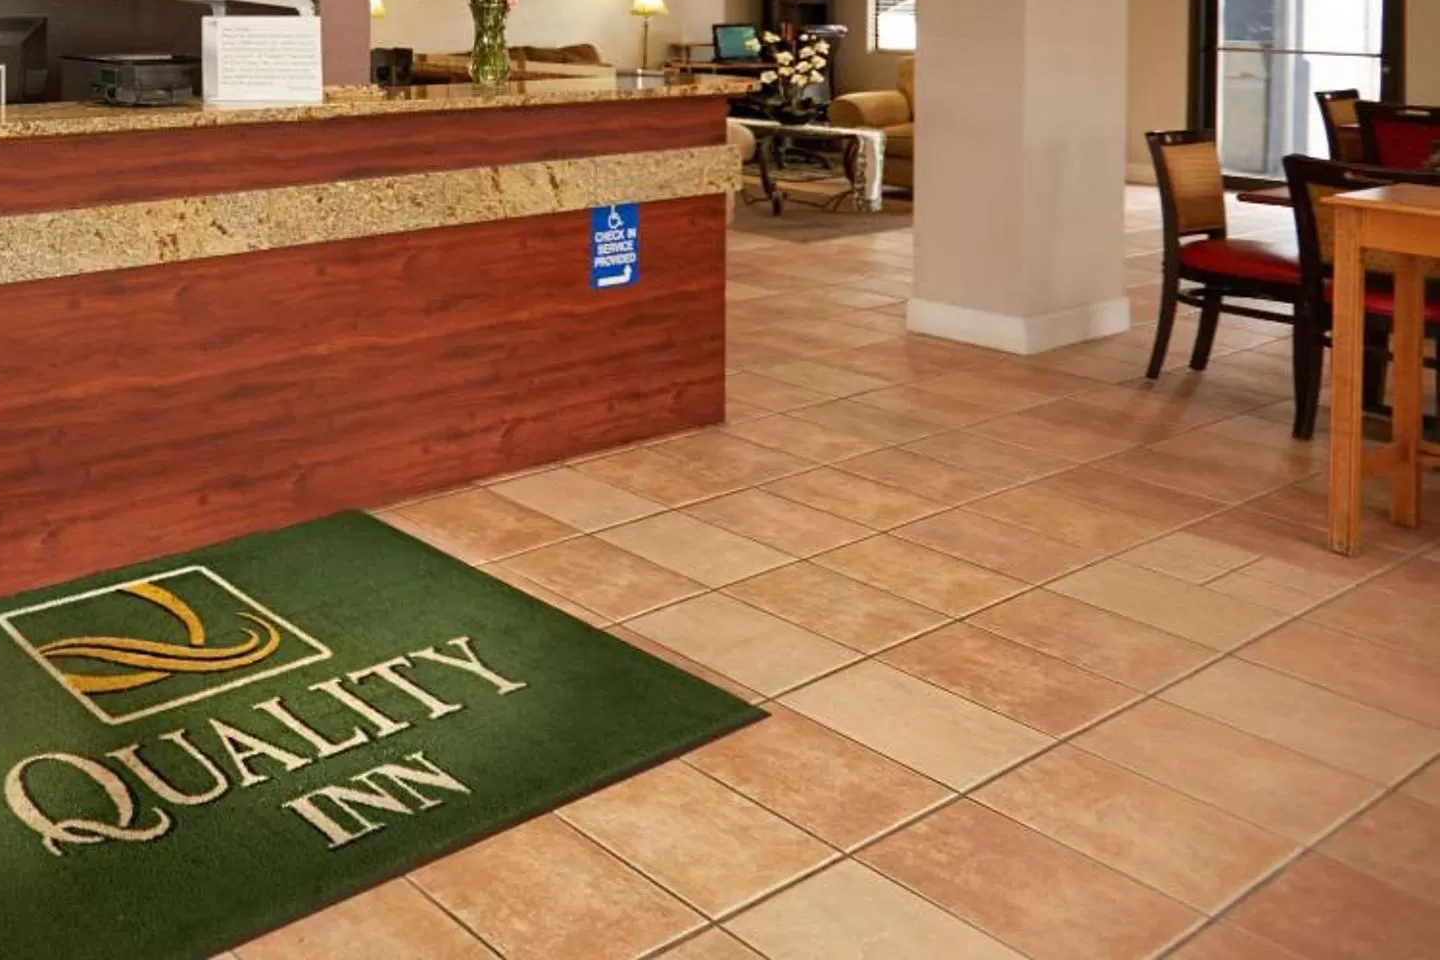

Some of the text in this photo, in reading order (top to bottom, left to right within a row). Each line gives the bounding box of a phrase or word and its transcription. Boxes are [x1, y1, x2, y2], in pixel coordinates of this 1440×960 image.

[595, 228, 636, 243] CHECK IN
[597, 240, 634, 255] SERVICE
[594, 252, 637, 268] PROVIDED
[4, 637, 526, 856] QUALITY
[281, 751, 473, 849] INN
